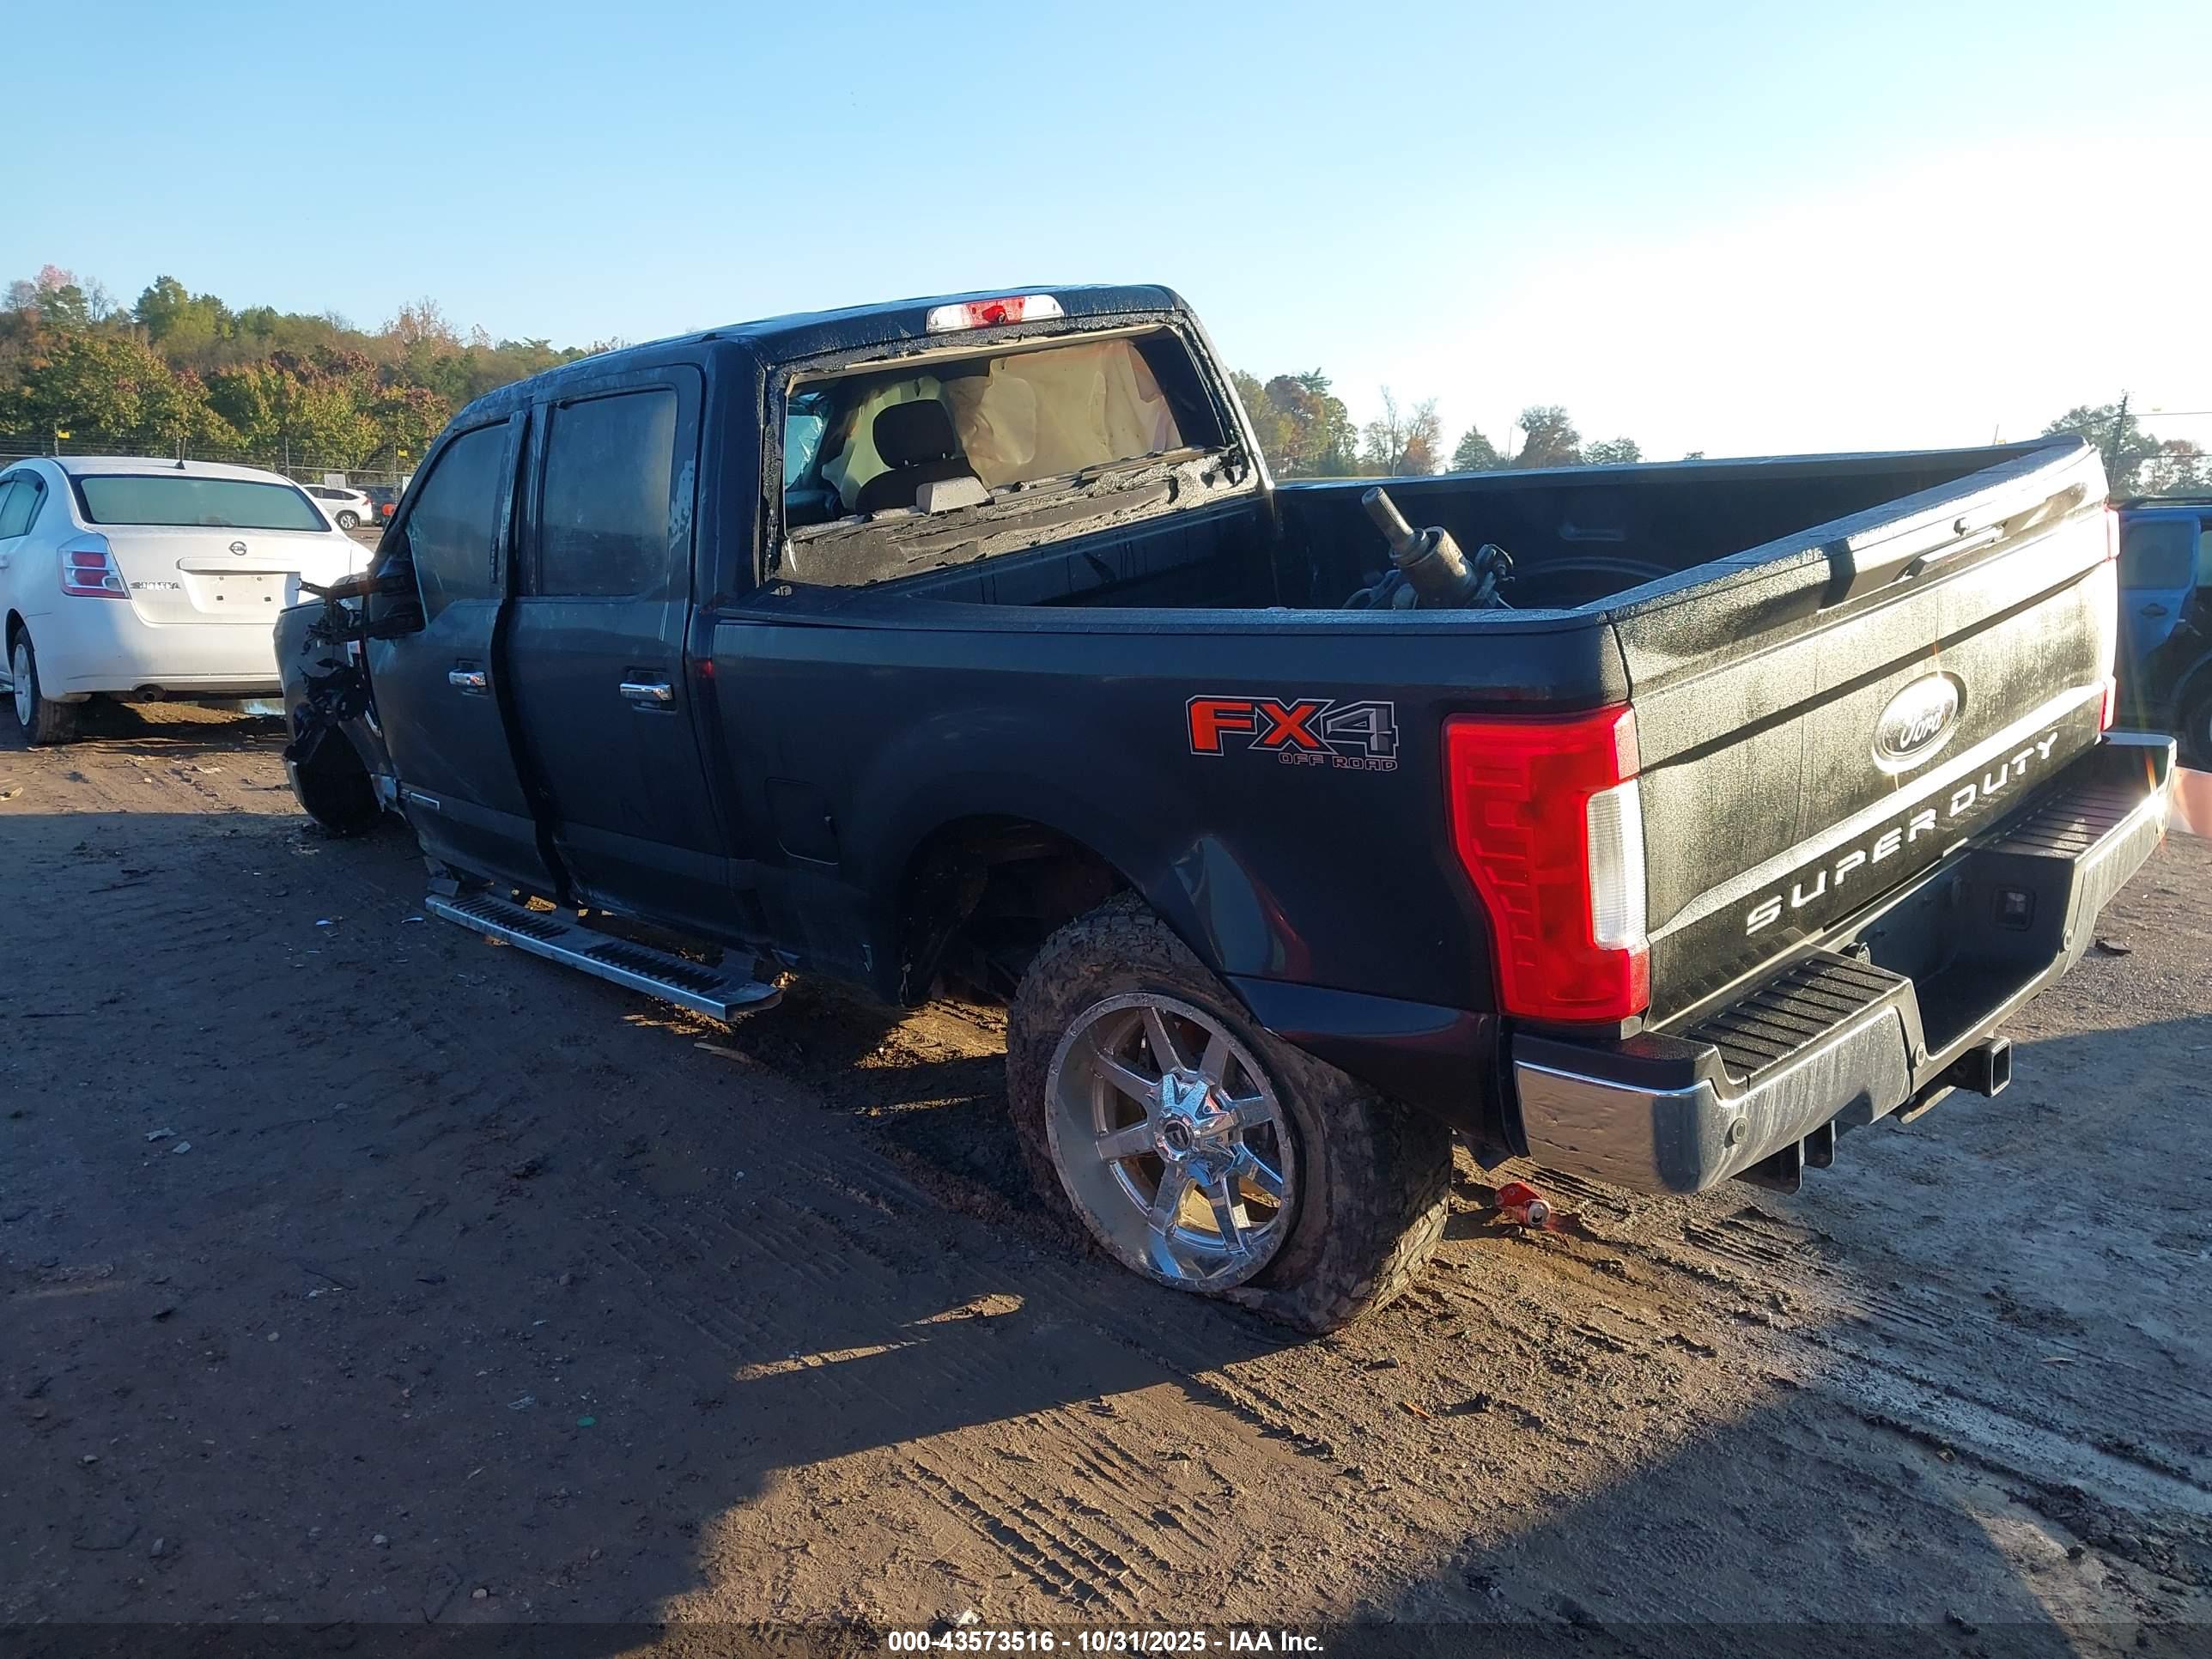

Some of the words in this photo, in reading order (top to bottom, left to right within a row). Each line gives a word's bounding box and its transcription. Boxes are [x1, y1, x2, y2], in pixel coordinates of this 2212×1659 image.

[1186, 695, 1399, 759] FX4
[1278, 752, 1325, 766] OFF
[1332, 756, 1398, 772] ROAD
[1746, 808, 1937, 936] SUPER
[1949, 732, 2058, 817] DUTY
